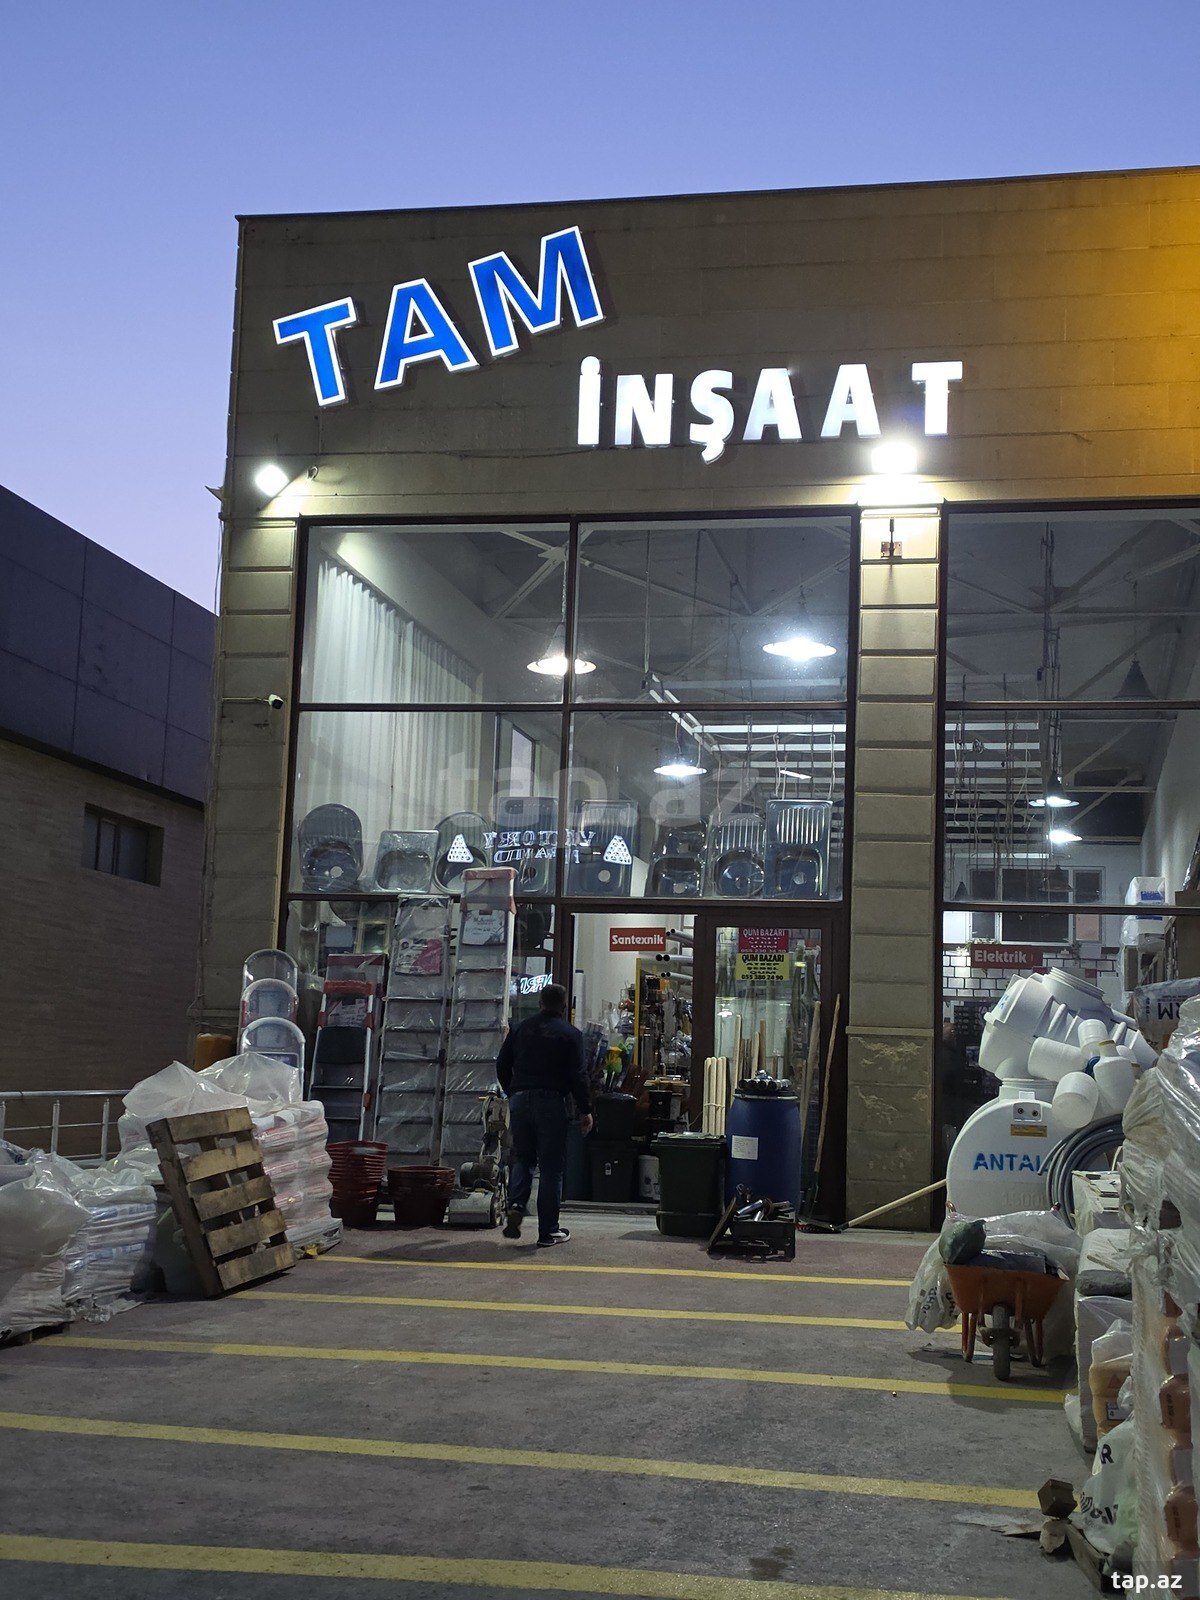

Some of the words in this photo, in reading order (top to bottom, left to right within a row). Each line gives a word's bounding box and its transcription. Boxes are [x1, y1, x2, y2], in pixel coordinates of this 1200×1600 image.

[272, 225, 604, 406] TAM
[577, 355, 963, 464] İNŞAAT
[743, 928, 759, 938] QUM
[611, 934, 664, 945] Santexnik
[742, 955, 758, 963] QUM
[974, 950, 1027, 963] Elektrik
